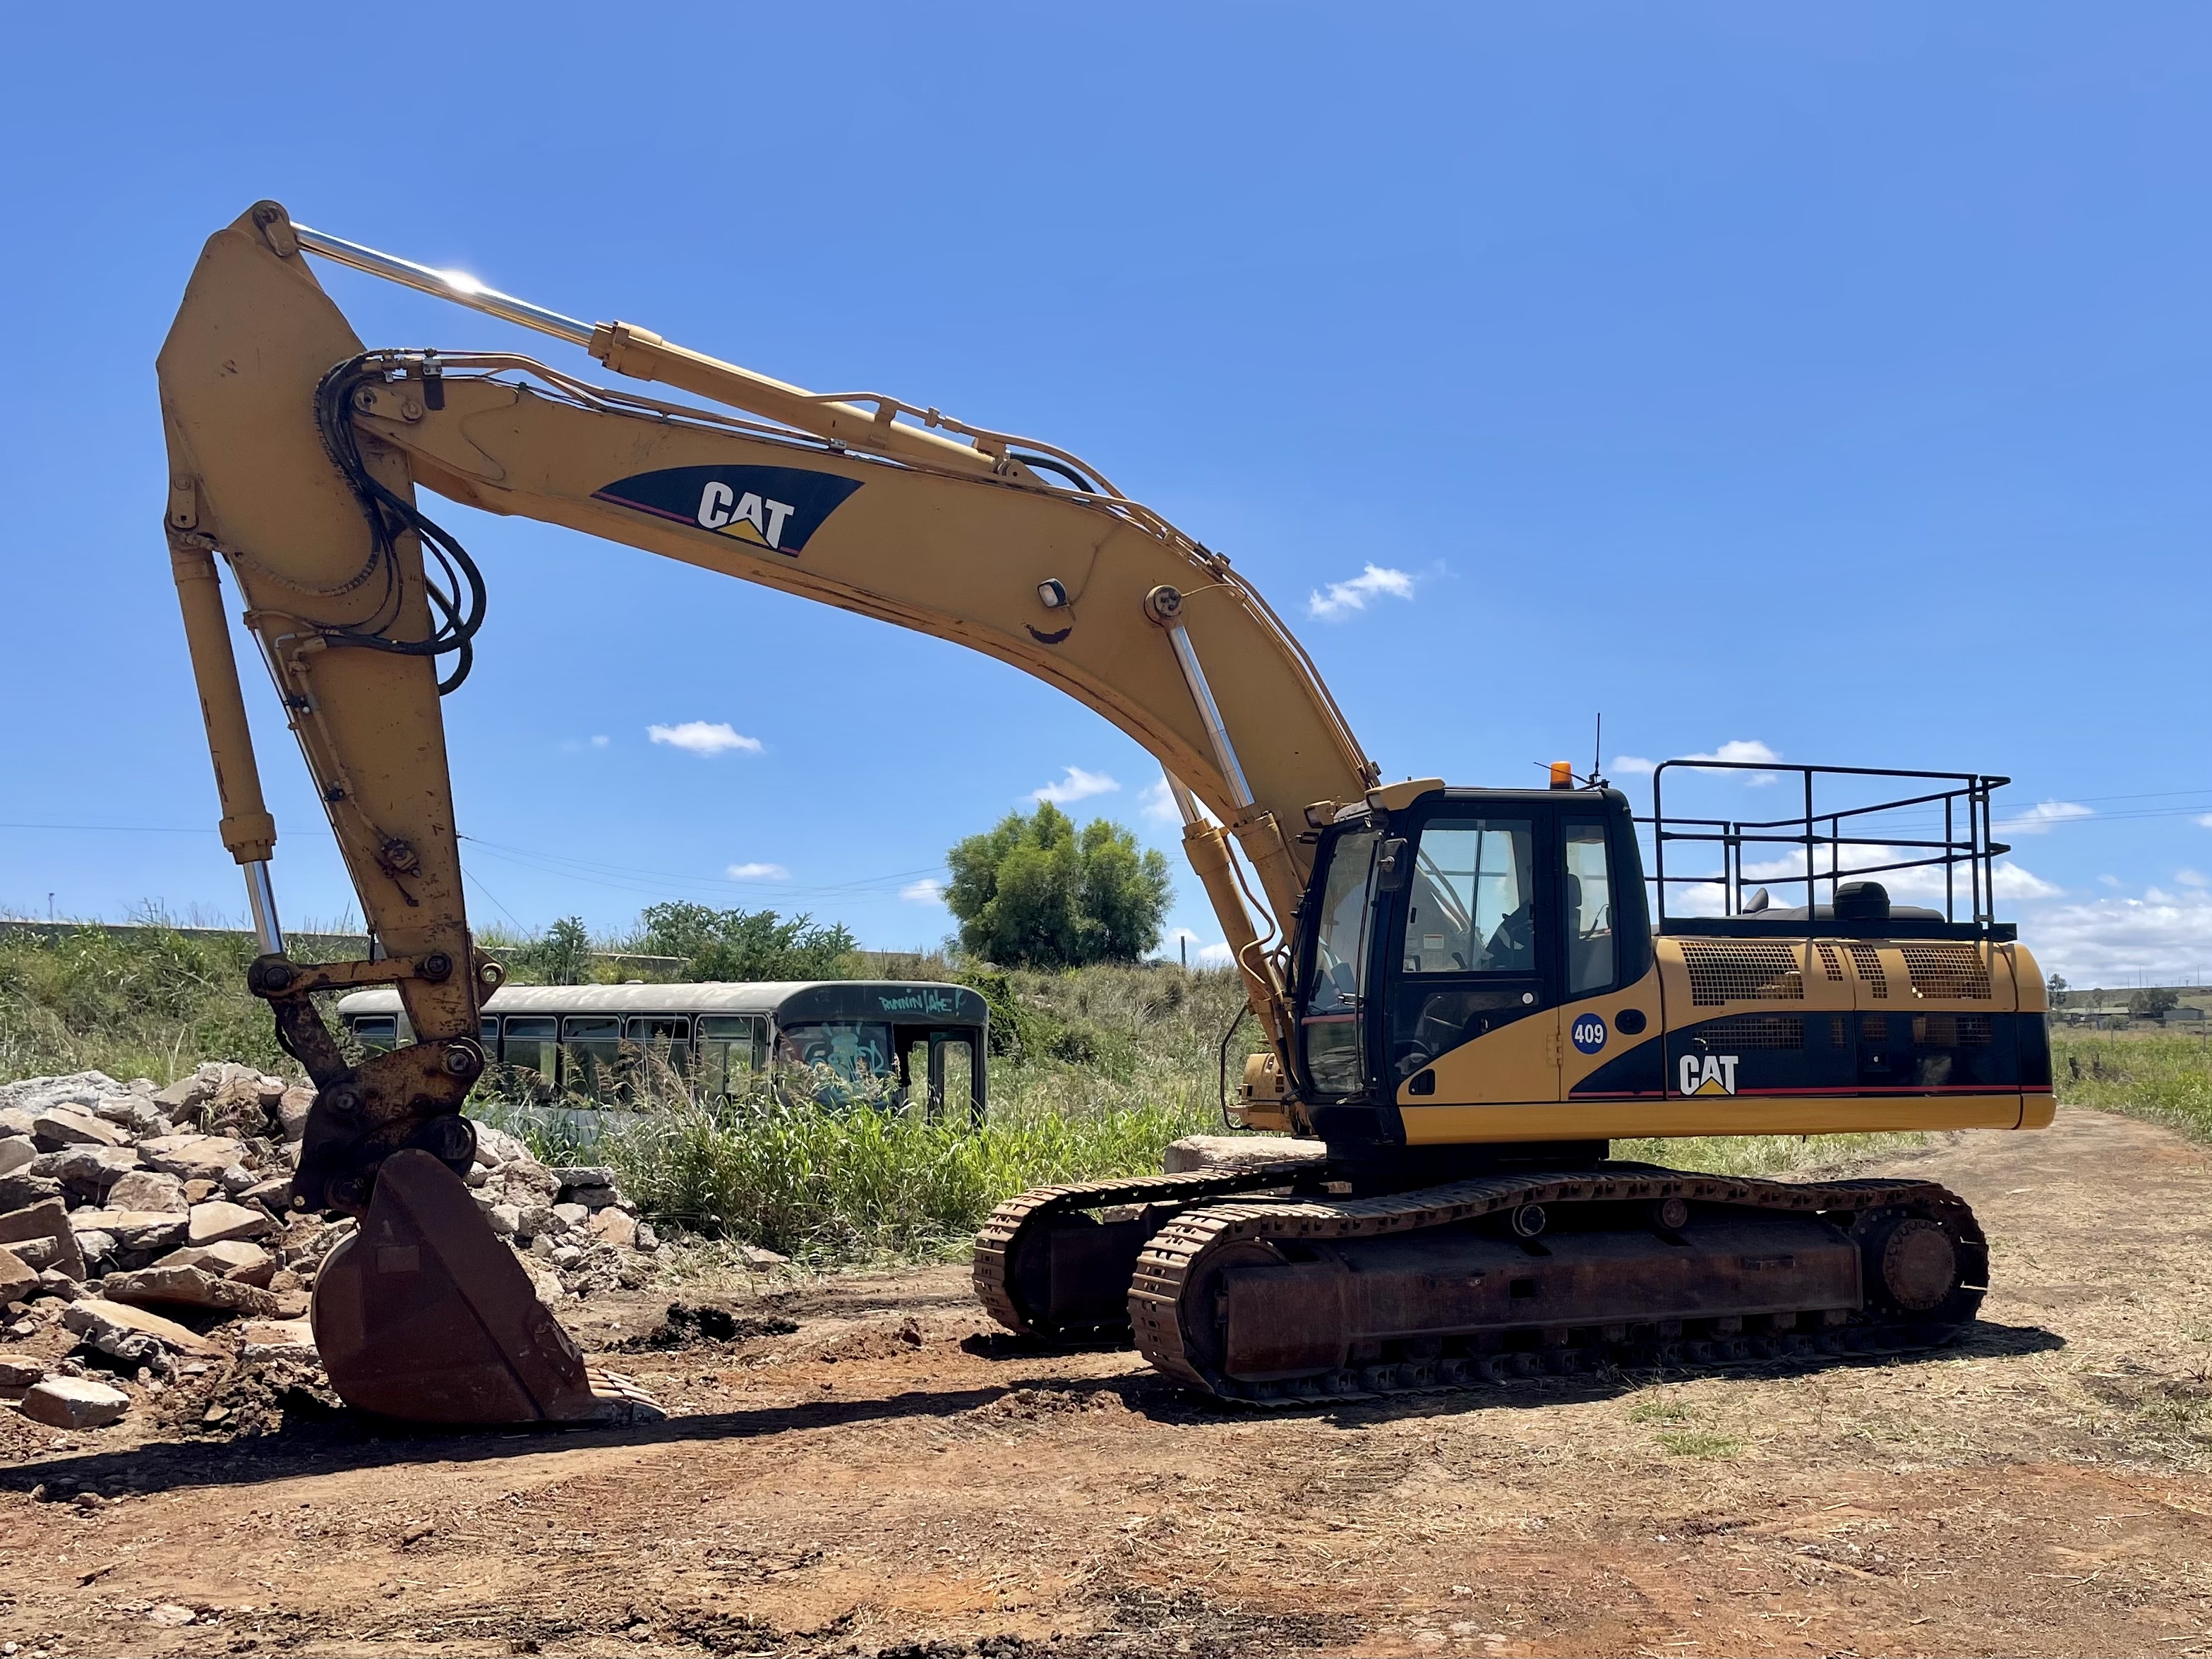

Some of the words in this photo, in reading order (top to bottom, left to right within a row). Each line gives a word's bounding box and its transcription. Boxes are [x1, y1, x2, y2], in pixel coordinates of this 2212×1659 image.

[698, 481, 795, 549] CAT
[1575, 1024, 1604, 1044] 409
[1680, 1055, 1738, 1095] CAT
